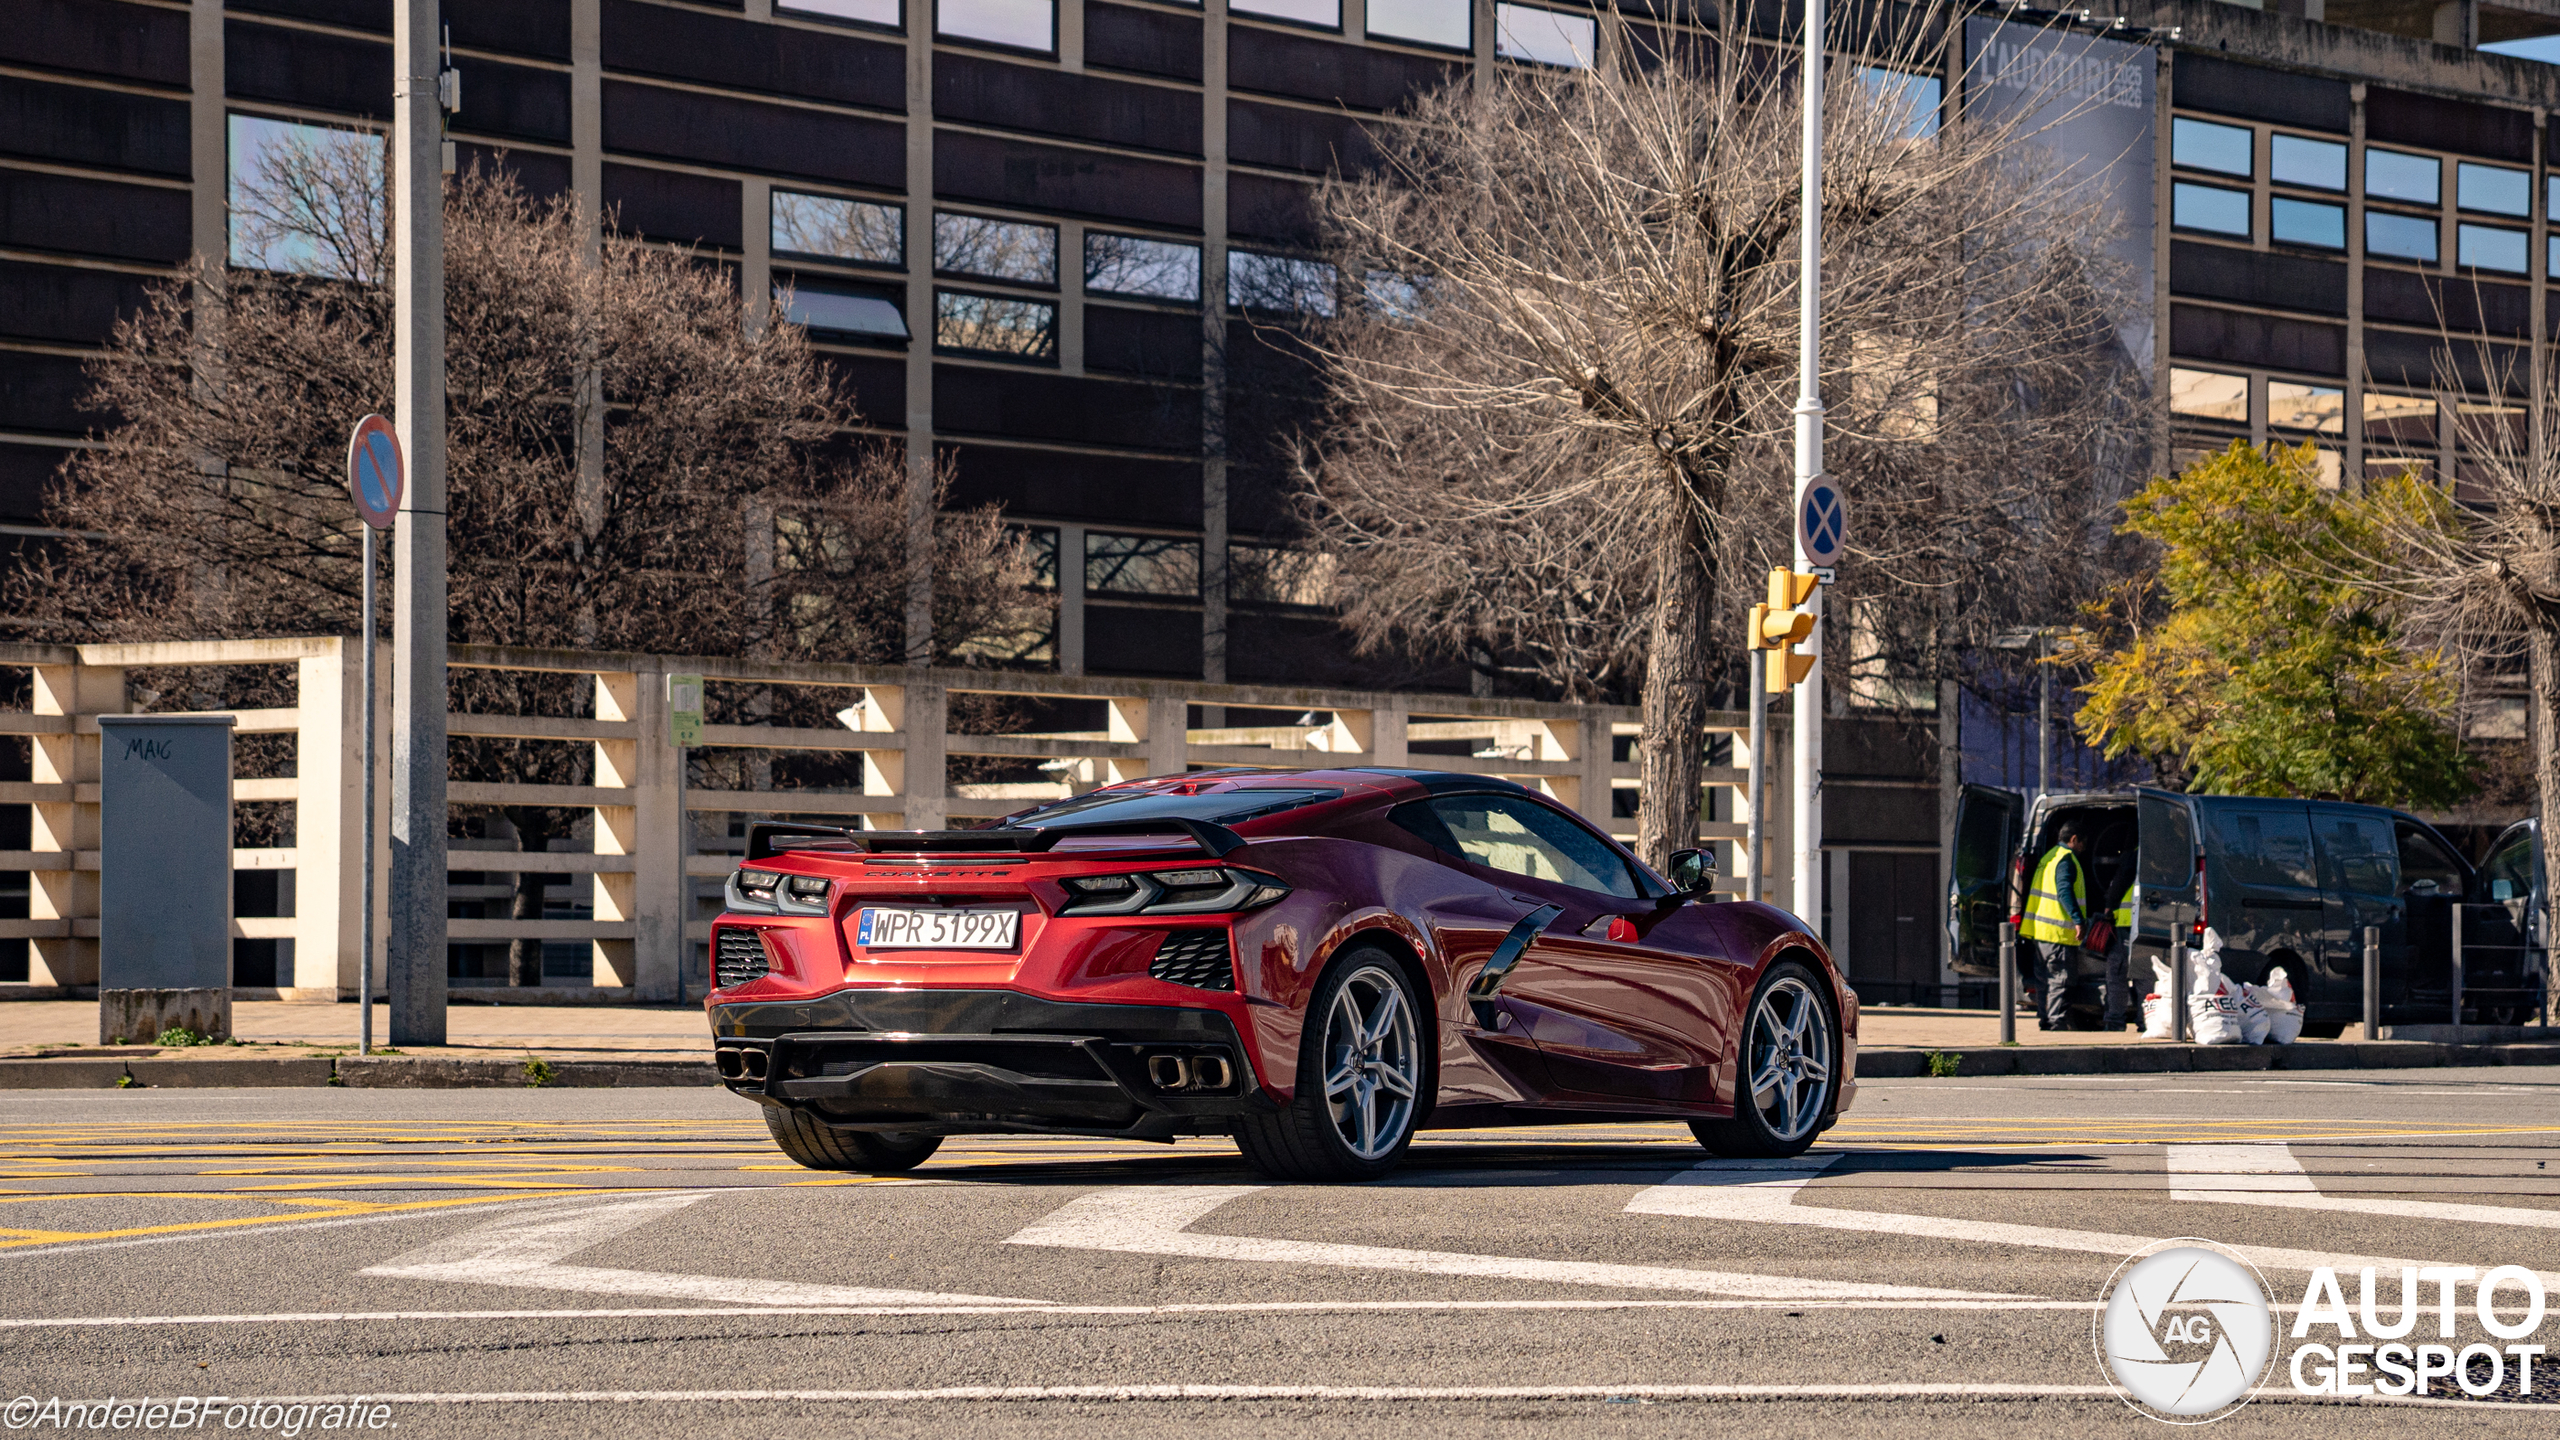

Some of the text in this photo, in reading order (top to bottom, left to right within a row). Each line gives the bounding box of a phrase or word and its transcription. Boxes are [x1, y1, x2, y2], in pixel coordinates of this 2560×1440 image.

[1980, 32, 2111, 102] L'AUDITORI
[859, 931, 870, 940] PL
[874, 913, 1014, 943] WPR 5199X
